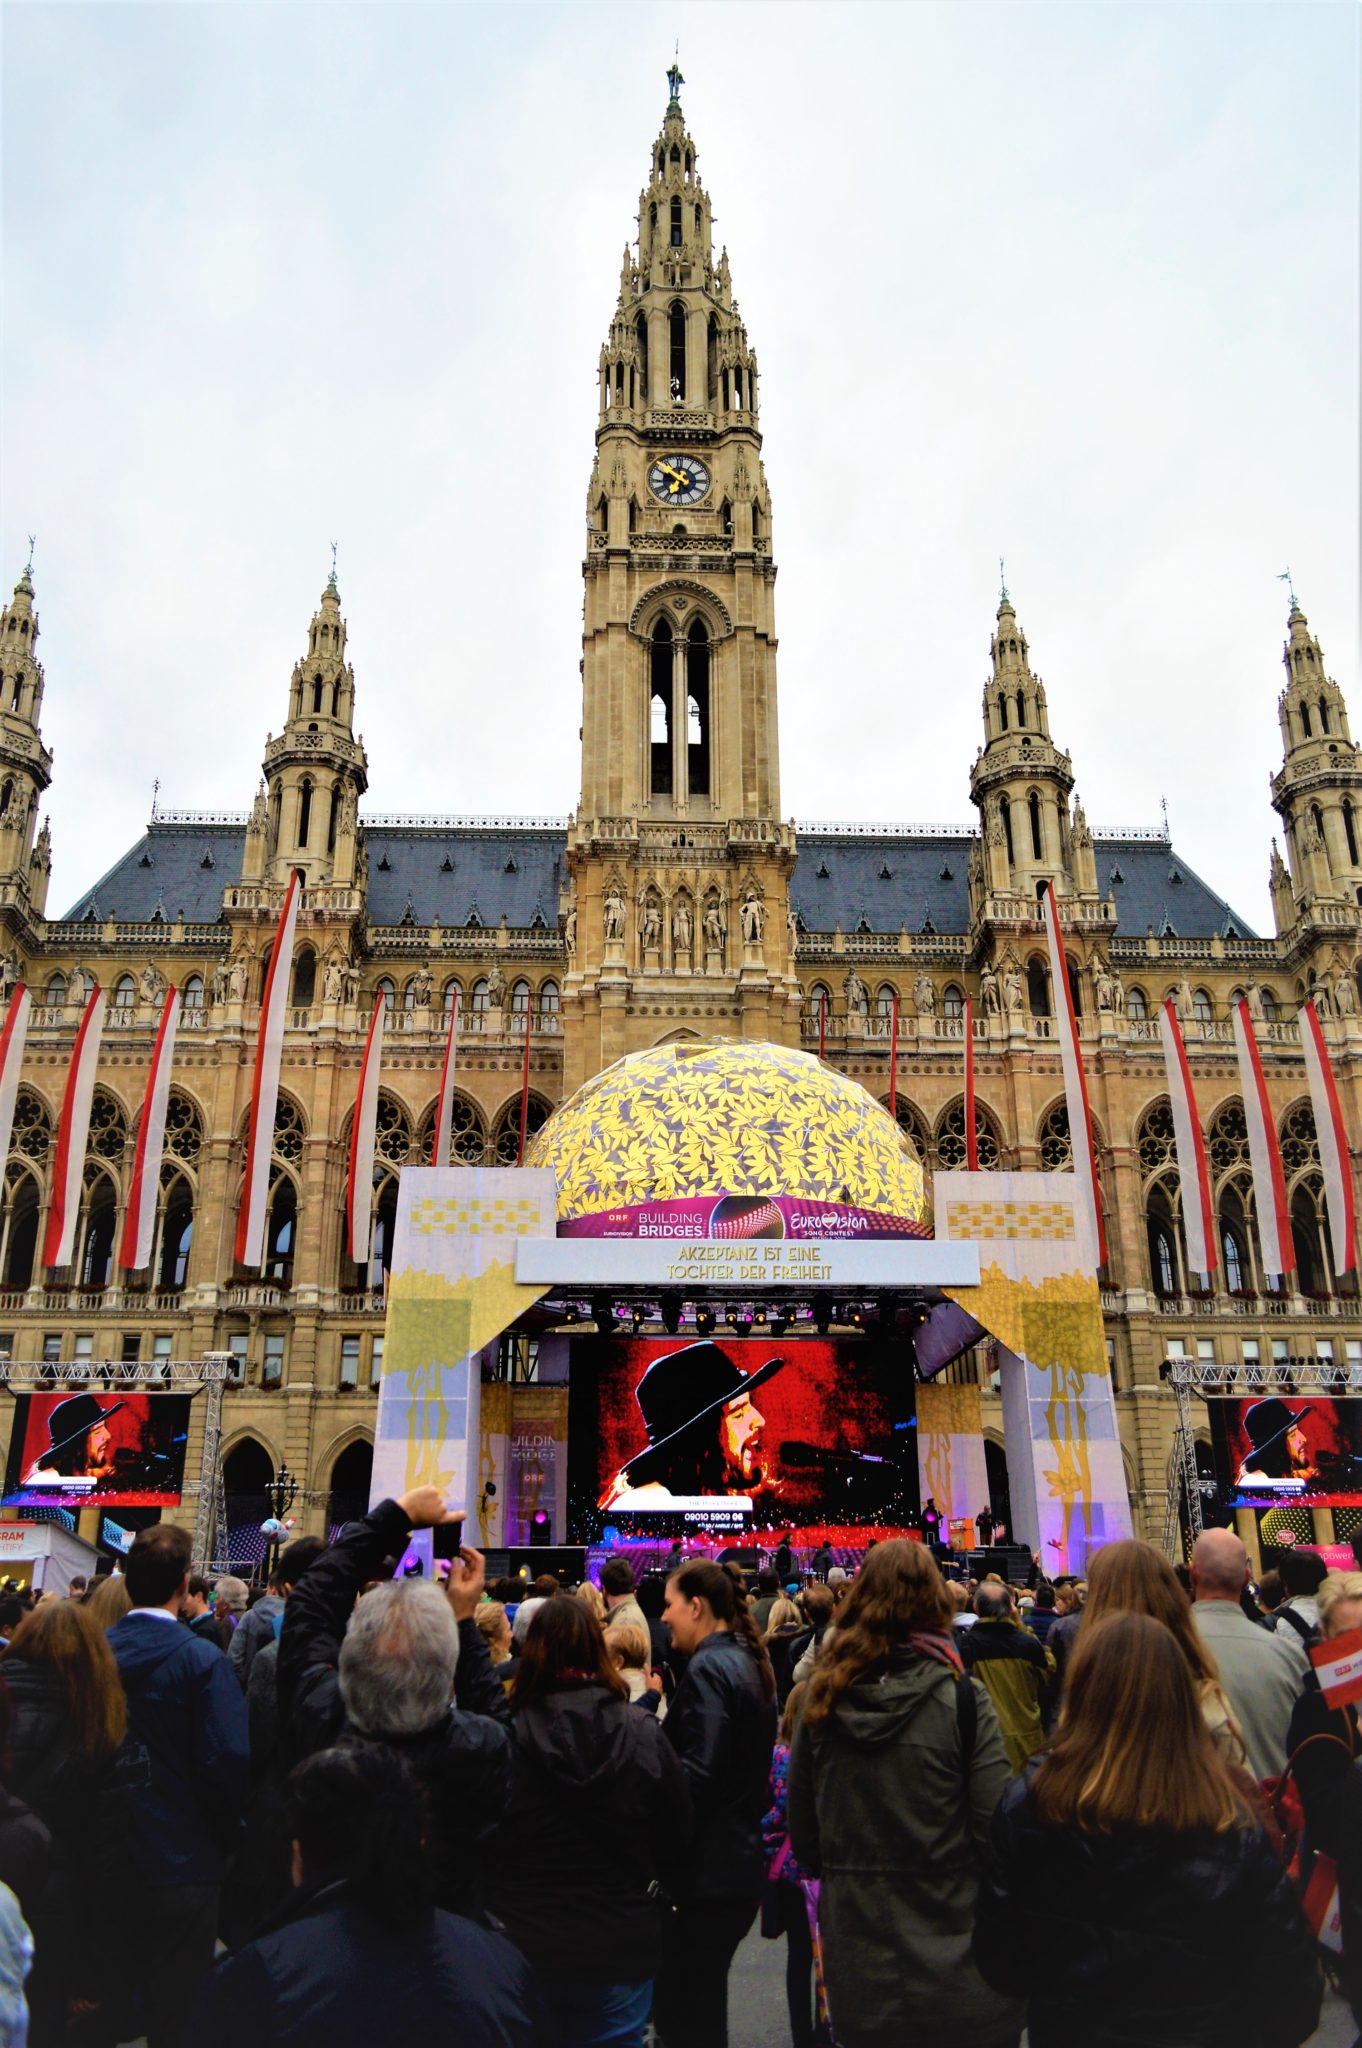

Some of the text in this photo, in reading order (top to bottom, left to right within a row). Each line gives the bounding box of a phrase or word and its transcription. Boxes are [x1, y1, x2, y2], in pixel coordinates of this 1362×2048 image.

[638, 1213, 703, 1224] BUILDING
[638, 1225, 703, 1237] BRIDGES
[678, 1247, 821, 1261] AKZEPTANZ IST EINE
[667, 1265, 832, 1280] TOCHTER DER FREIHEIT
[684, 1512, 709, 1521] 09010
